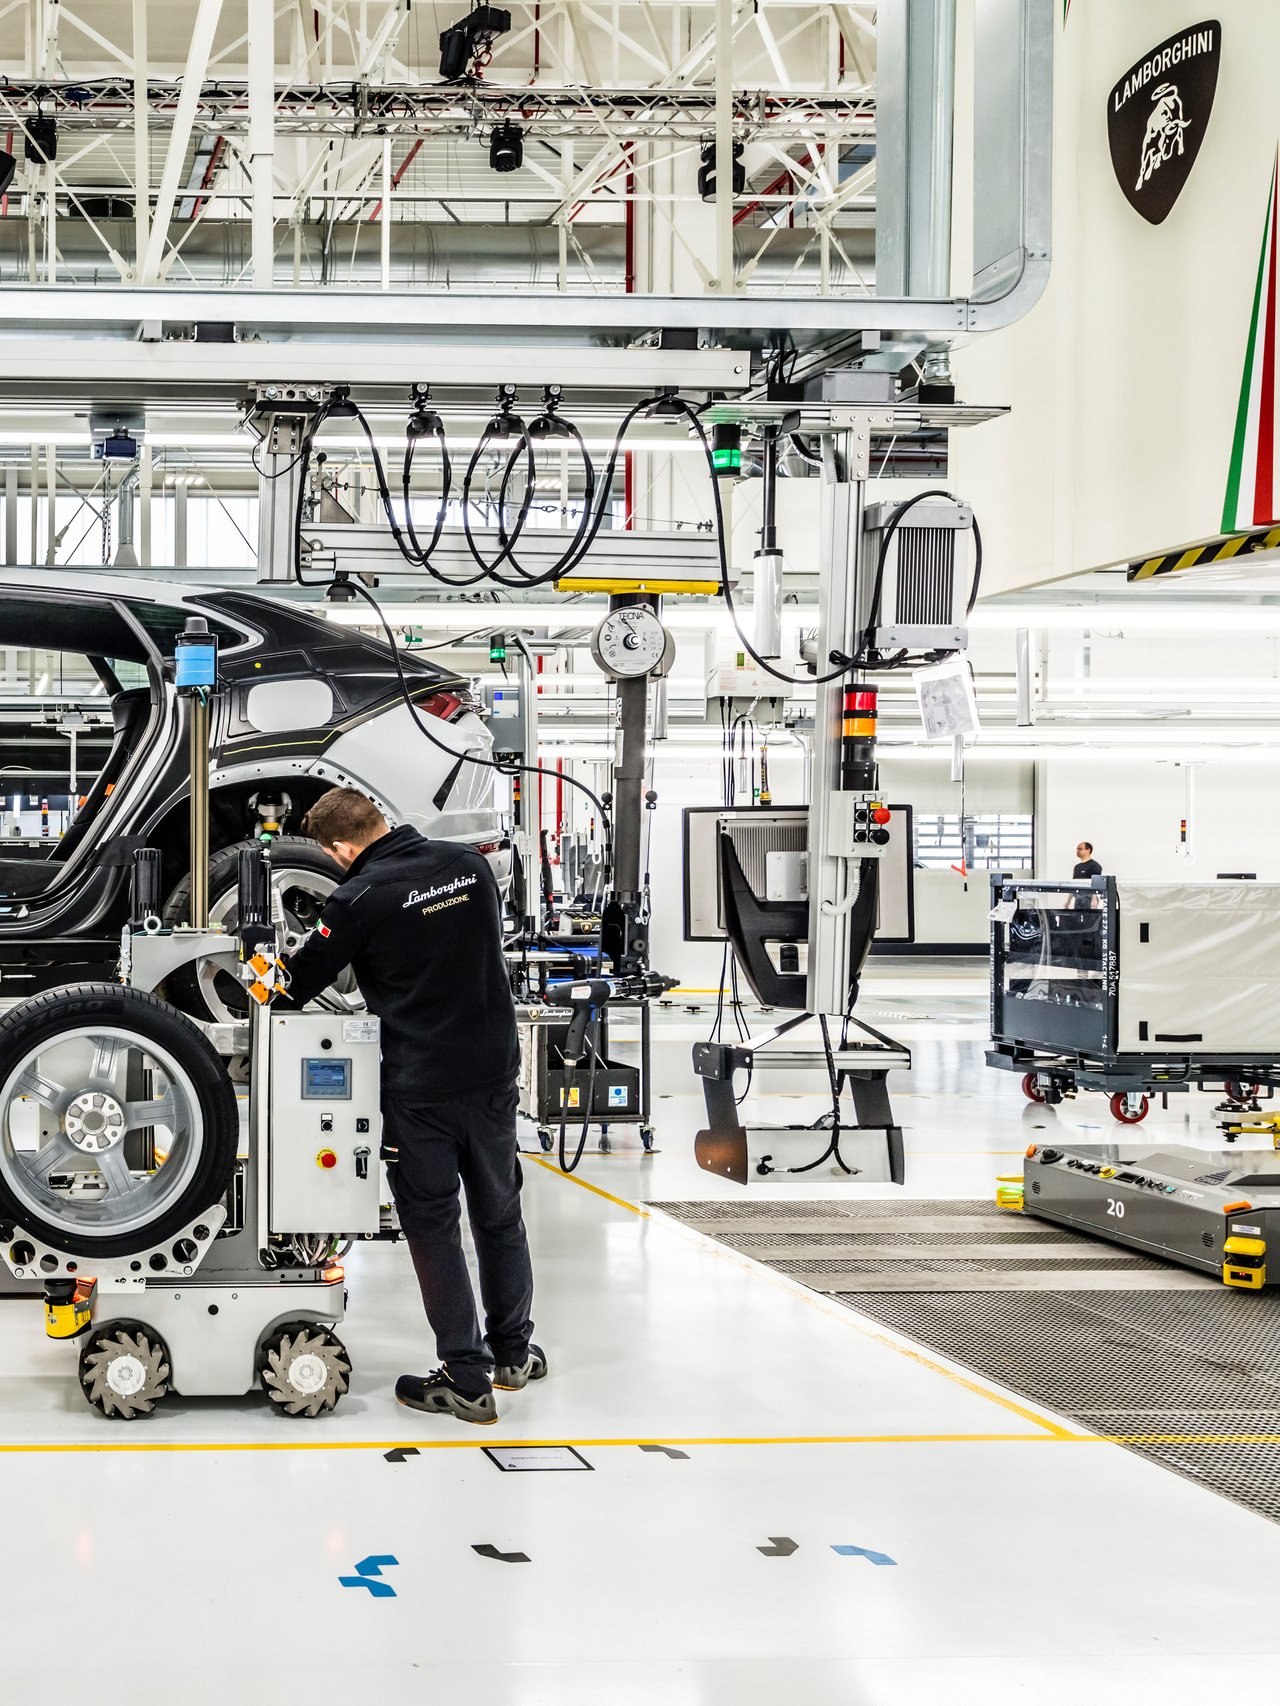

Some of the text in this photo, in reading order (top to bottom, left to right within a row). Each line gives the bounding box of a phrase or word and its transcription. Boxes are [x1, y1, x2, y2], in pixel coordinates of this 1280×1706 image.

[1114, 30, 1213, 113] LAMBORGHINI
[617, 611, 645, 621] TECNA
[402, 873, 478, 908] Lamborghini
[422, 893, 470, 916] PRODUZIONE
[1106, 1198, 1125, 1218] 20
